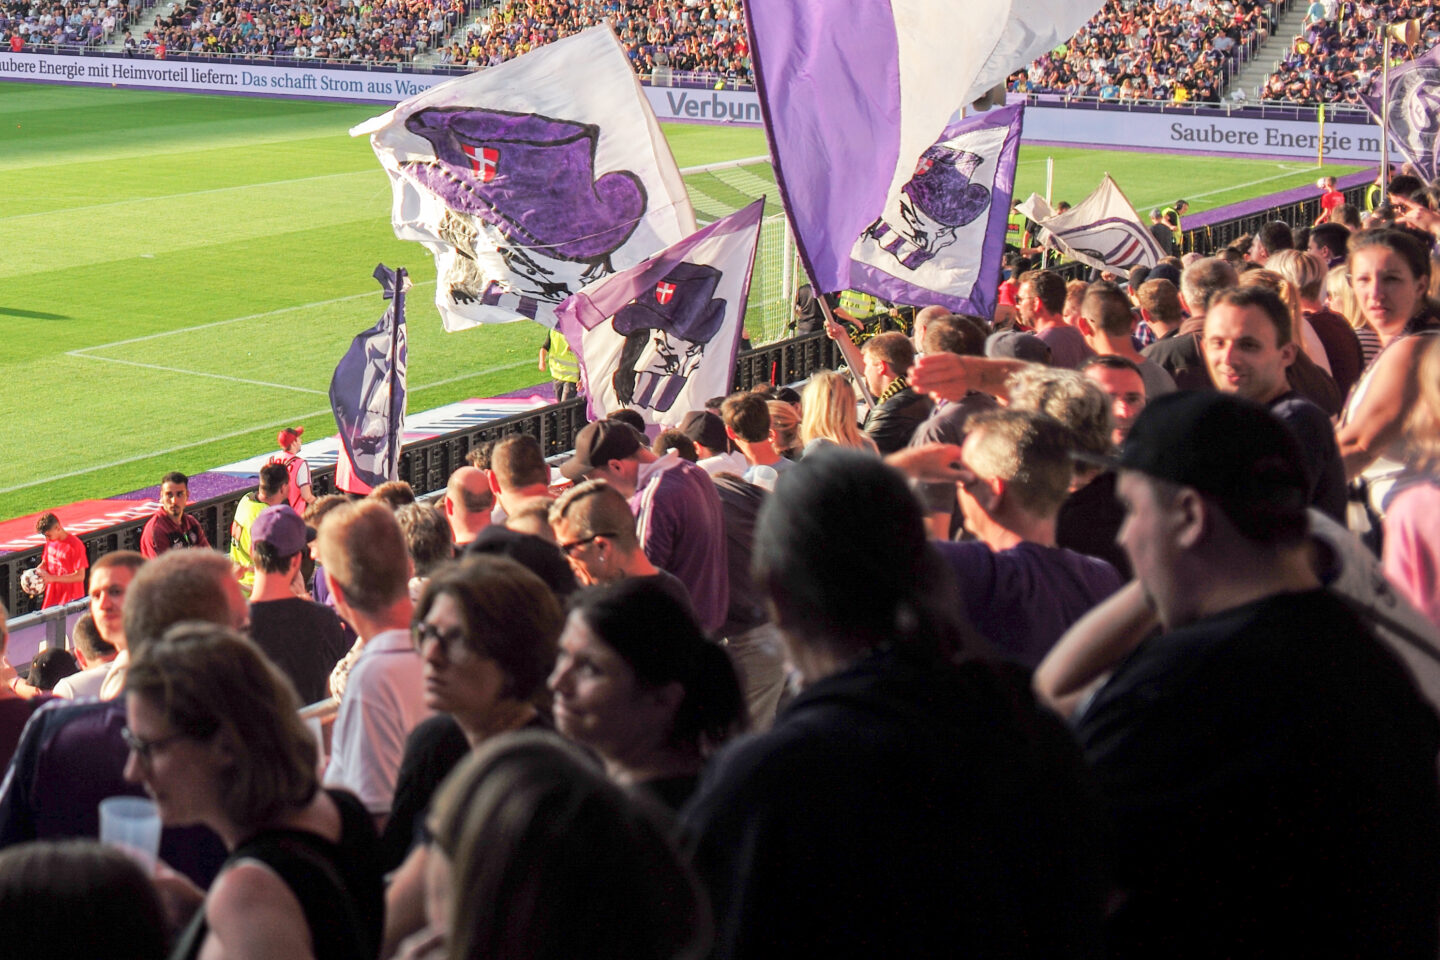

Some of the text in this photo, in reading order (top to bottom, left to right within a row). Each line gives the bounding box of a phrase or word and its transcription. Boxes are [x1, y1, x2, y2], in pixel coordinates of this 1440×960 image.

[39, 60, 85, 80] Energie
[88, 62, 109, 77] mit
[112, 64, 188, 82] Heimvorteil
[191, 68, 238, 85] liefern:
[242, 71, 268, 87] Das
[270, 72, 317, 90] schafft
[320, 76, 361, 93] Strom
[367, 81, 392, 95] aus
[666, 91, 761, 121] Verbun
[1170, 122, 1399, 155] Saubere Energie mt
